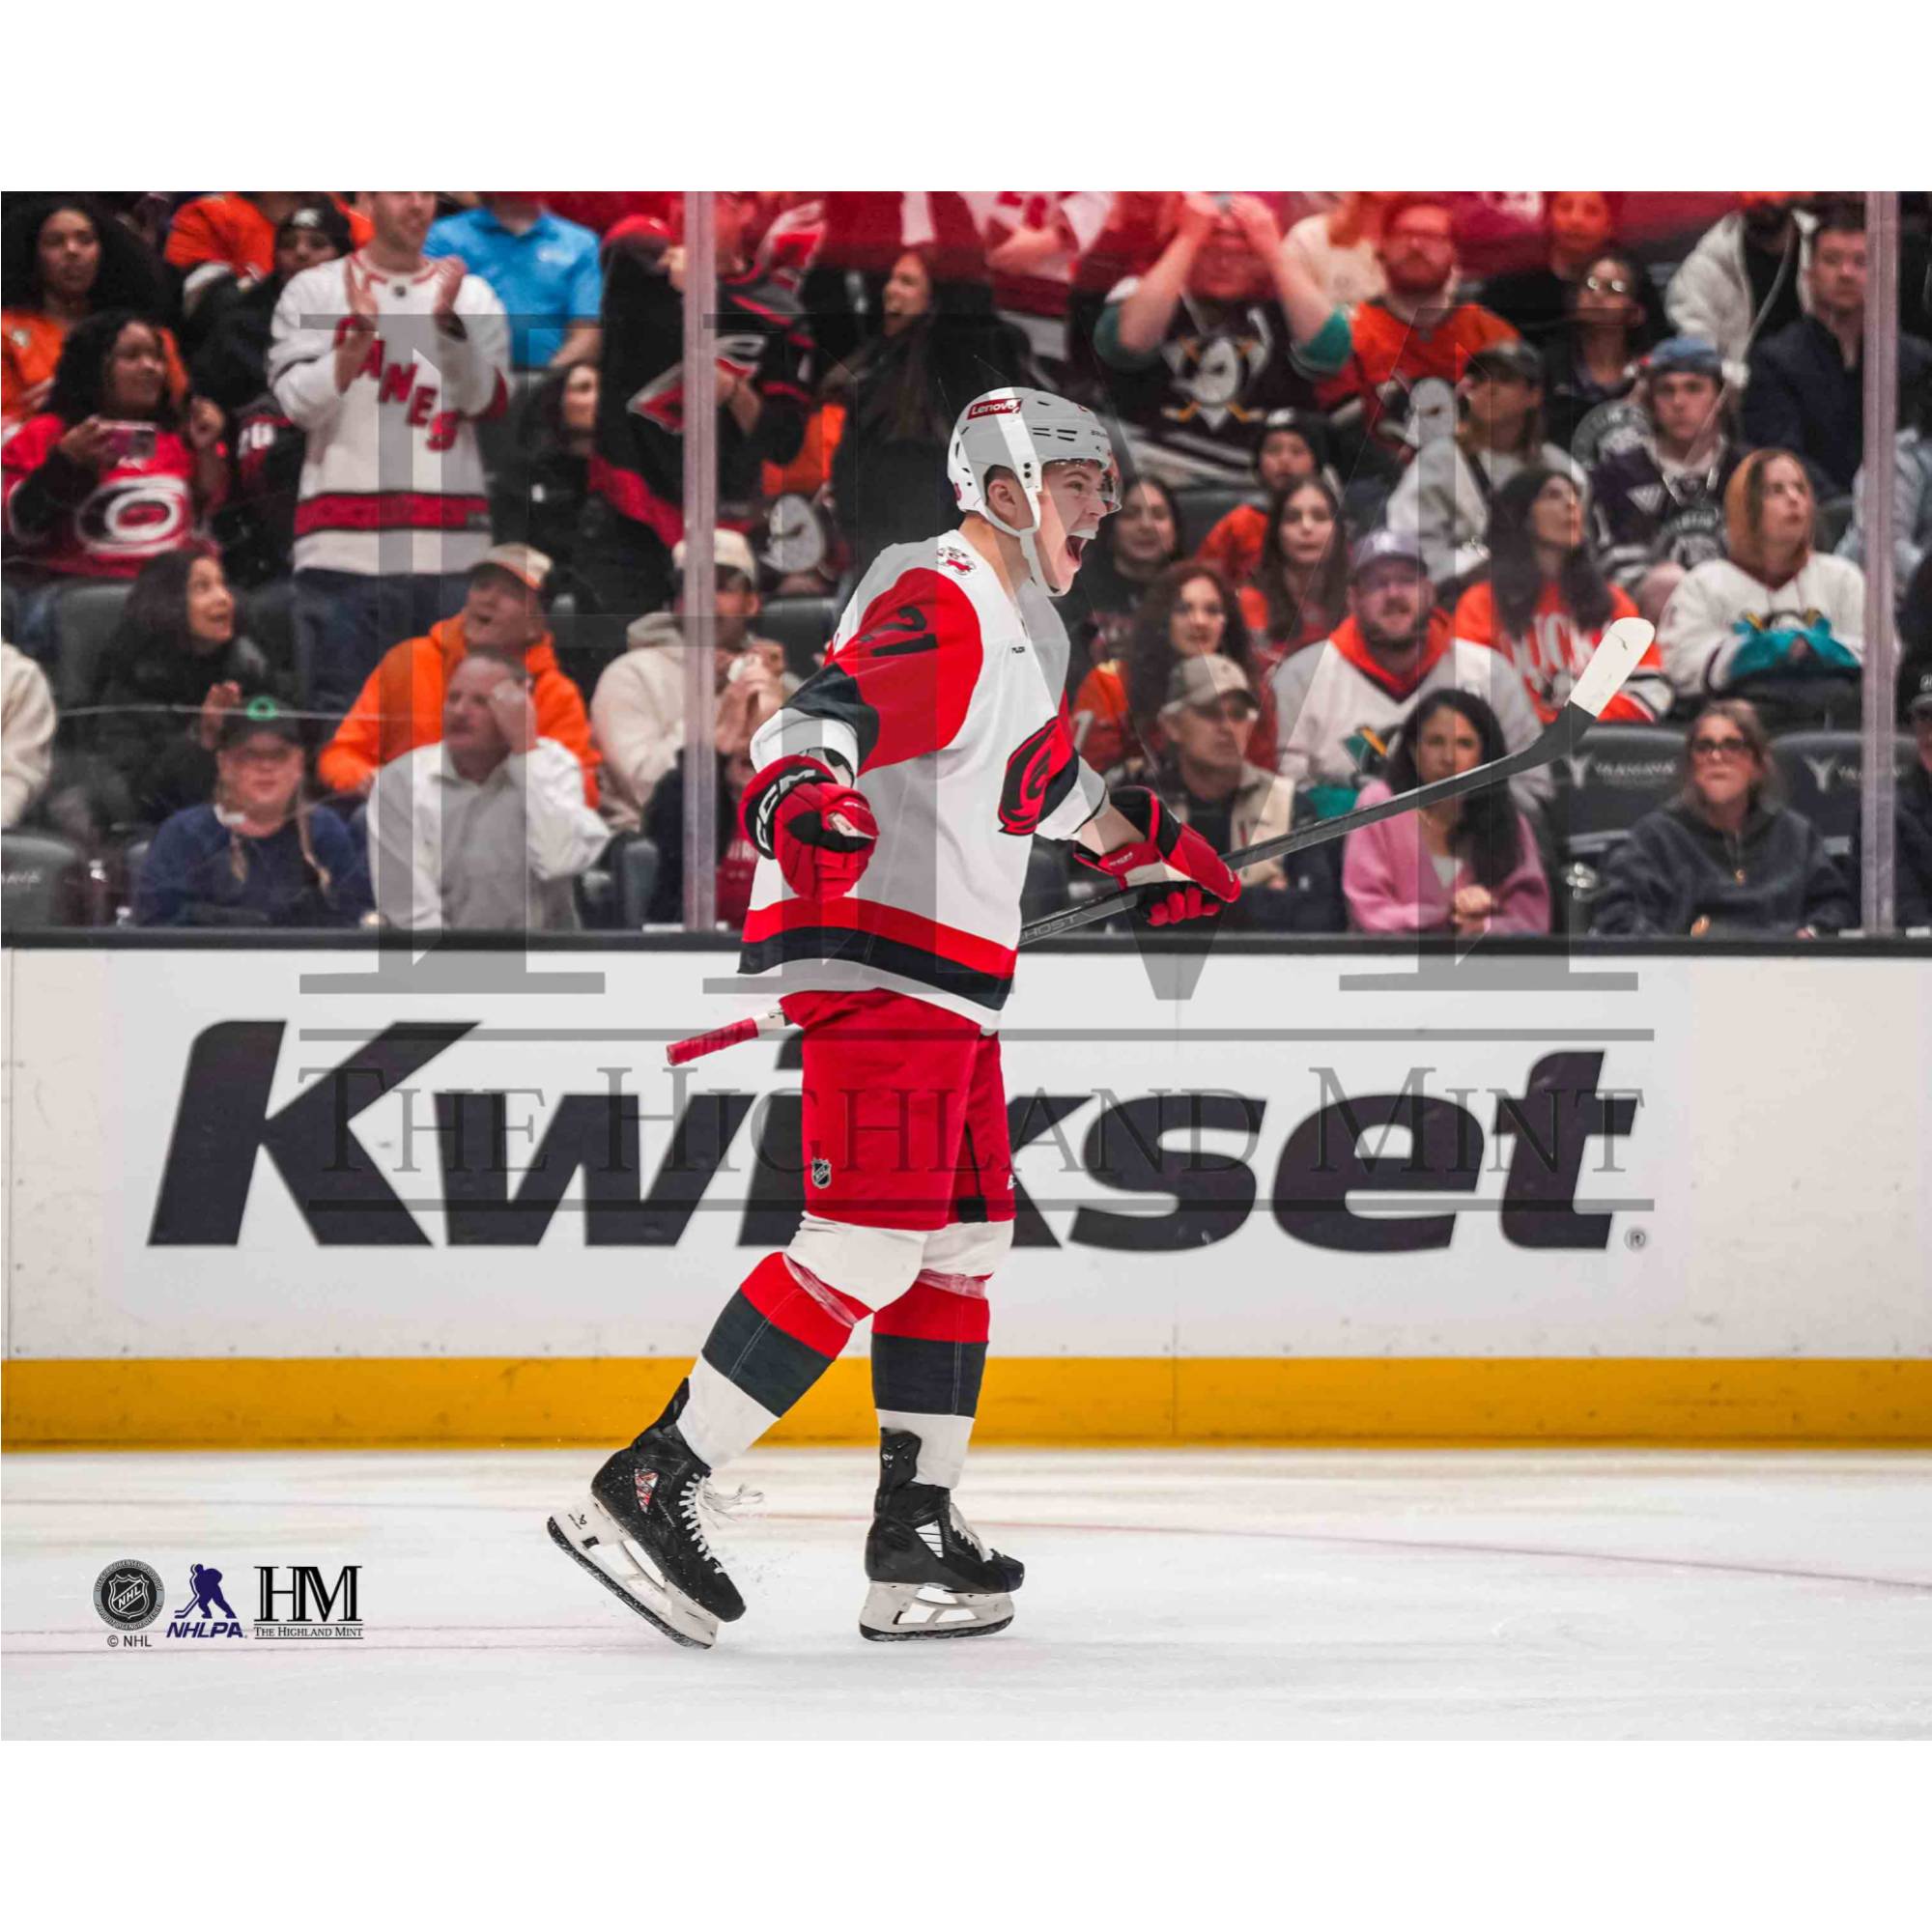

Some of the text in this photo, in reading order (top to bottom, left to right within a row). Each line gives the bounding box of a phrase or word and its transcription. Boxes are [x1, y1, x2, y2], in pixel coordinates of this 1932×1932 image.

[971, 402, 1015, 415] Lenovo
[756, 769, 816, 852] CCM
[1020, 913, 1079, 941] HOST
